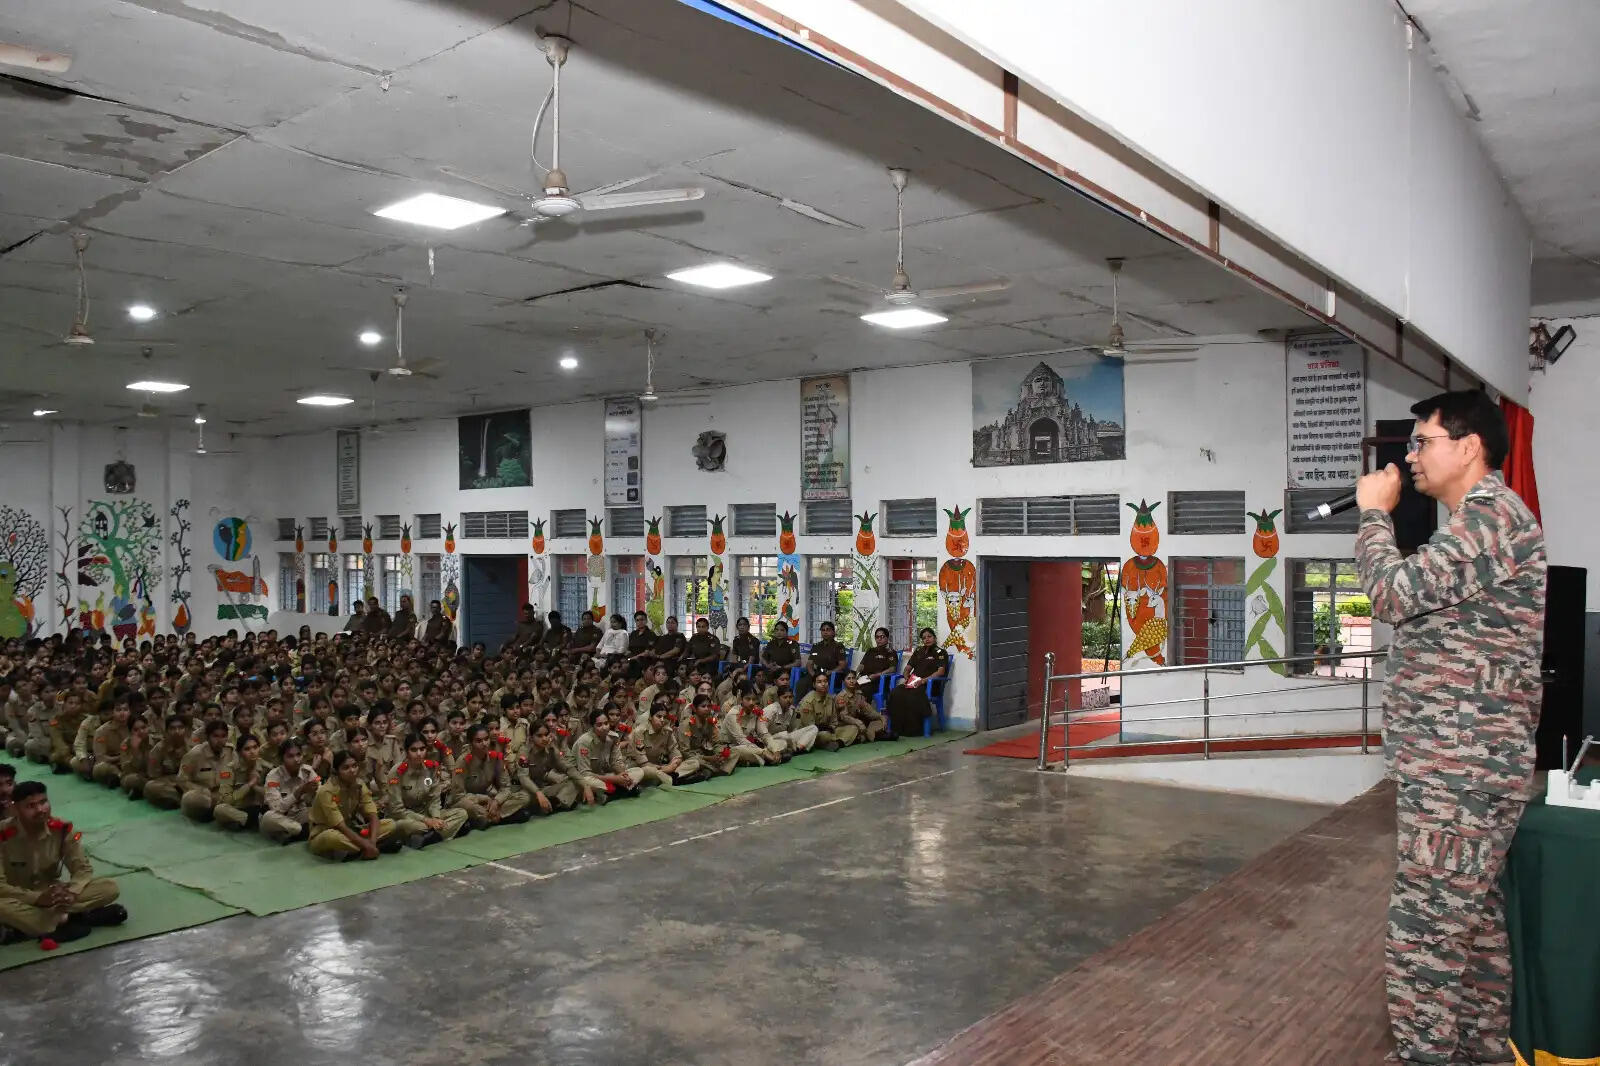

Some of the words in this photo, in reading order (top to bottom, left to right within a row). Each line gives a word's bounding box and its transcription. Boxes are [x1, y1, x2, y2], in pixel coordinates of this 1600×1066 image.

[1305, 471, 1314, 480] जय
[1327, 470, 1336, 479] जय
[1337, 470, 1349, 479] भारत
